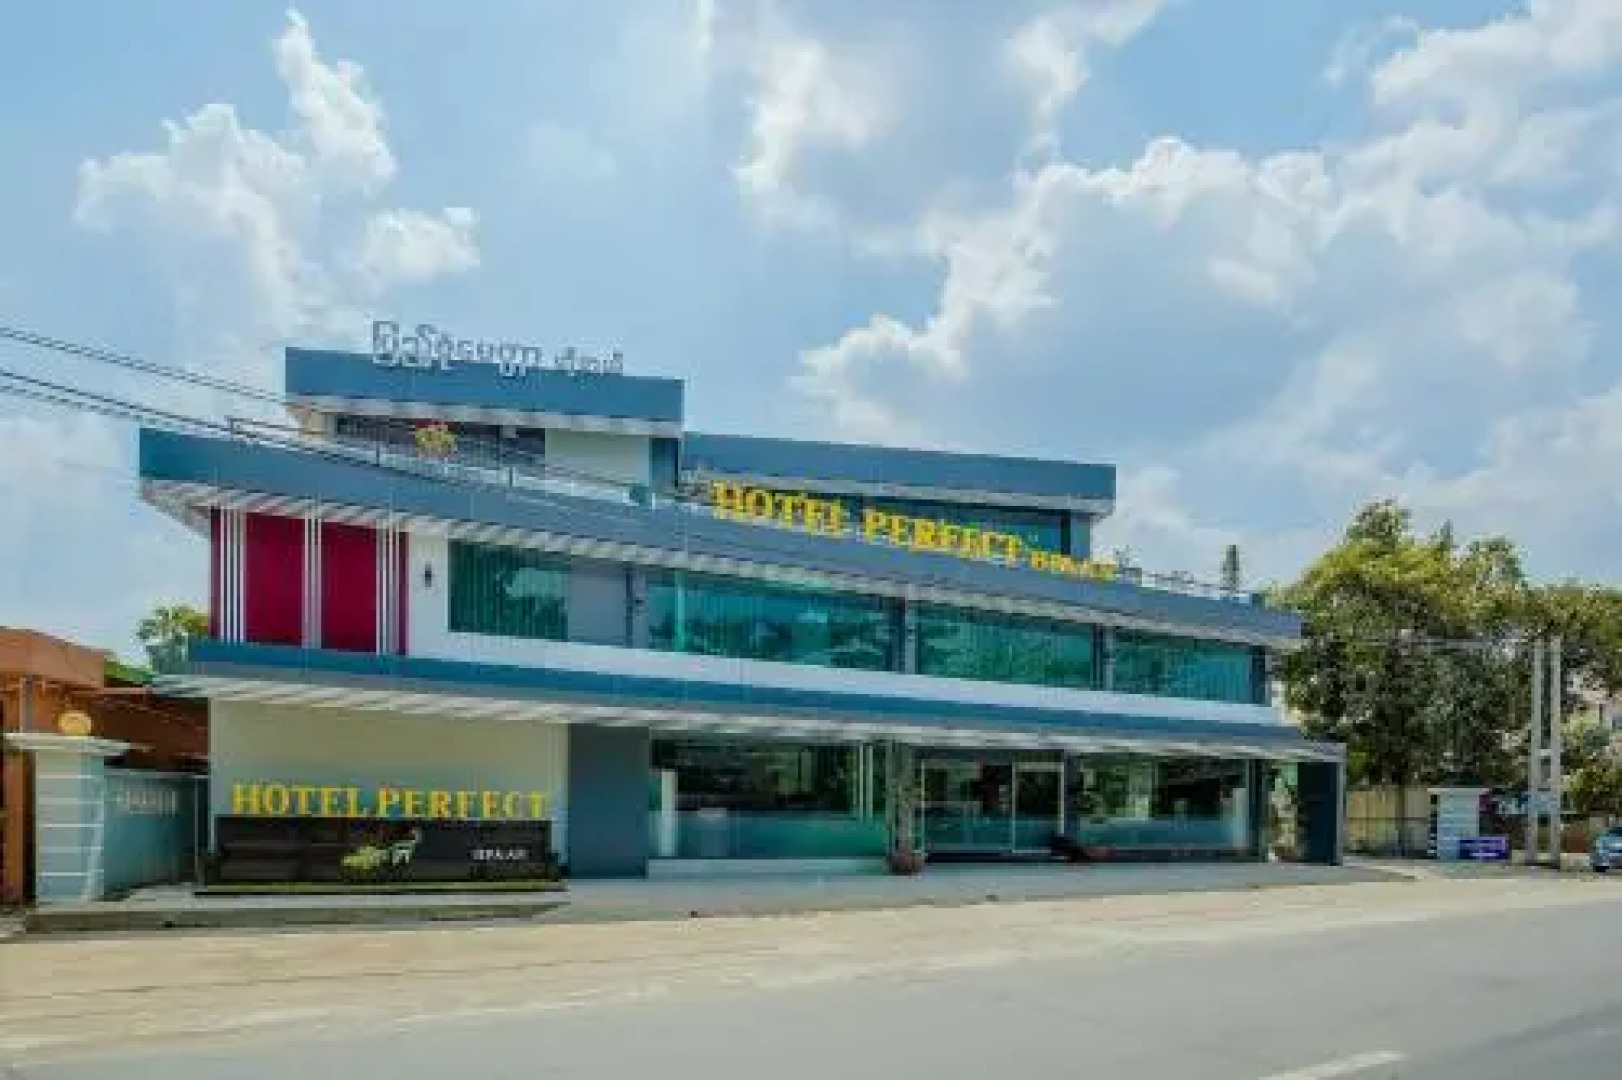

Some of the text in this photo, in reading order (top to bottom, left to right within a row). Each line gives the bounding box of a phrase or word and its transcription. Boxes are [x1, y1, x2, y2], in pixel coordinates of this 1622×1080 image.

[711, 480, 847, 536] HOTEL
[860, 508, 1025, 567] PERFECT
[231, 782, 548, 818] HOTEL PERFECT
